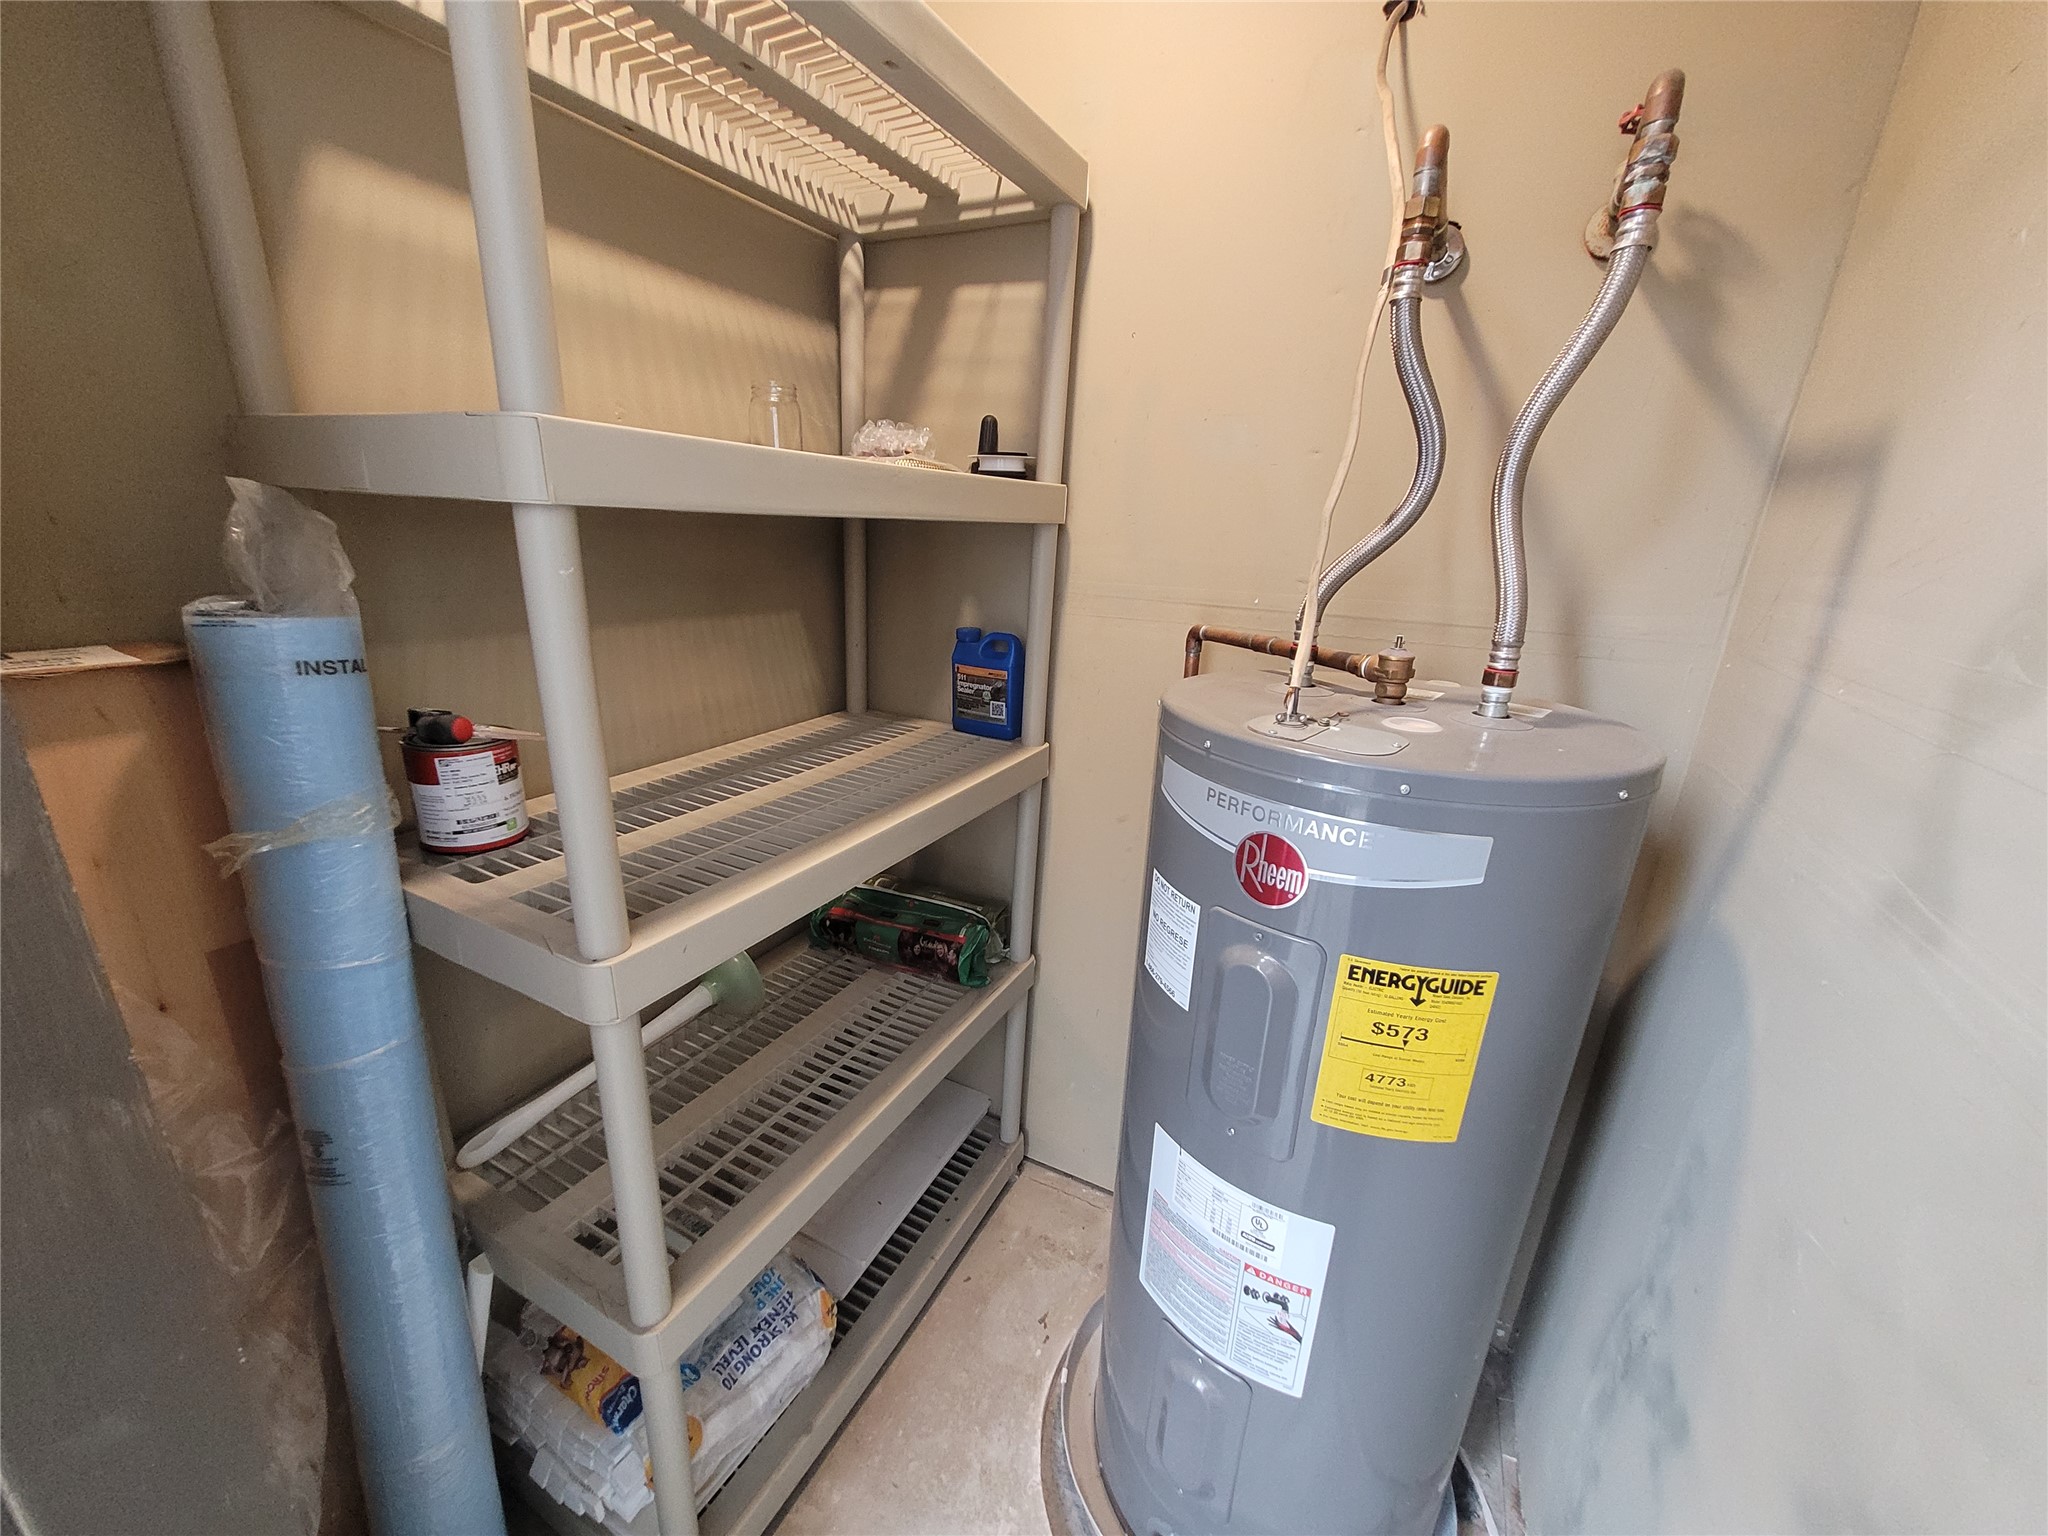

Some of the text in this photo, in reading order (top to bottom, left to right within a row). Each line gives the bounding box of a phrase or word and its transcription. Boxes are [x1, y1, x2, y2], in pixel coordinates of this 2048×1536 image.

[1206, 787, 1374, 850] PERFORMANCE
[1240, 833, 1302, 895] Rheem
[1160, 879, 1170, 895] NOT
[1170, 889, 1196, 915] RETURN
[1160, 918, 1189, 950] REGRESE
[1347, 964, 1487, 999] ENERGYGUIDE
[1371, 1021, 1429, 1041] $573
[1364, 1073, 1407, 1088] 4773
[1258, 1270, 1309, 1296] DANGER
[721, 1309, 799, 1391] KE STRONG TO
